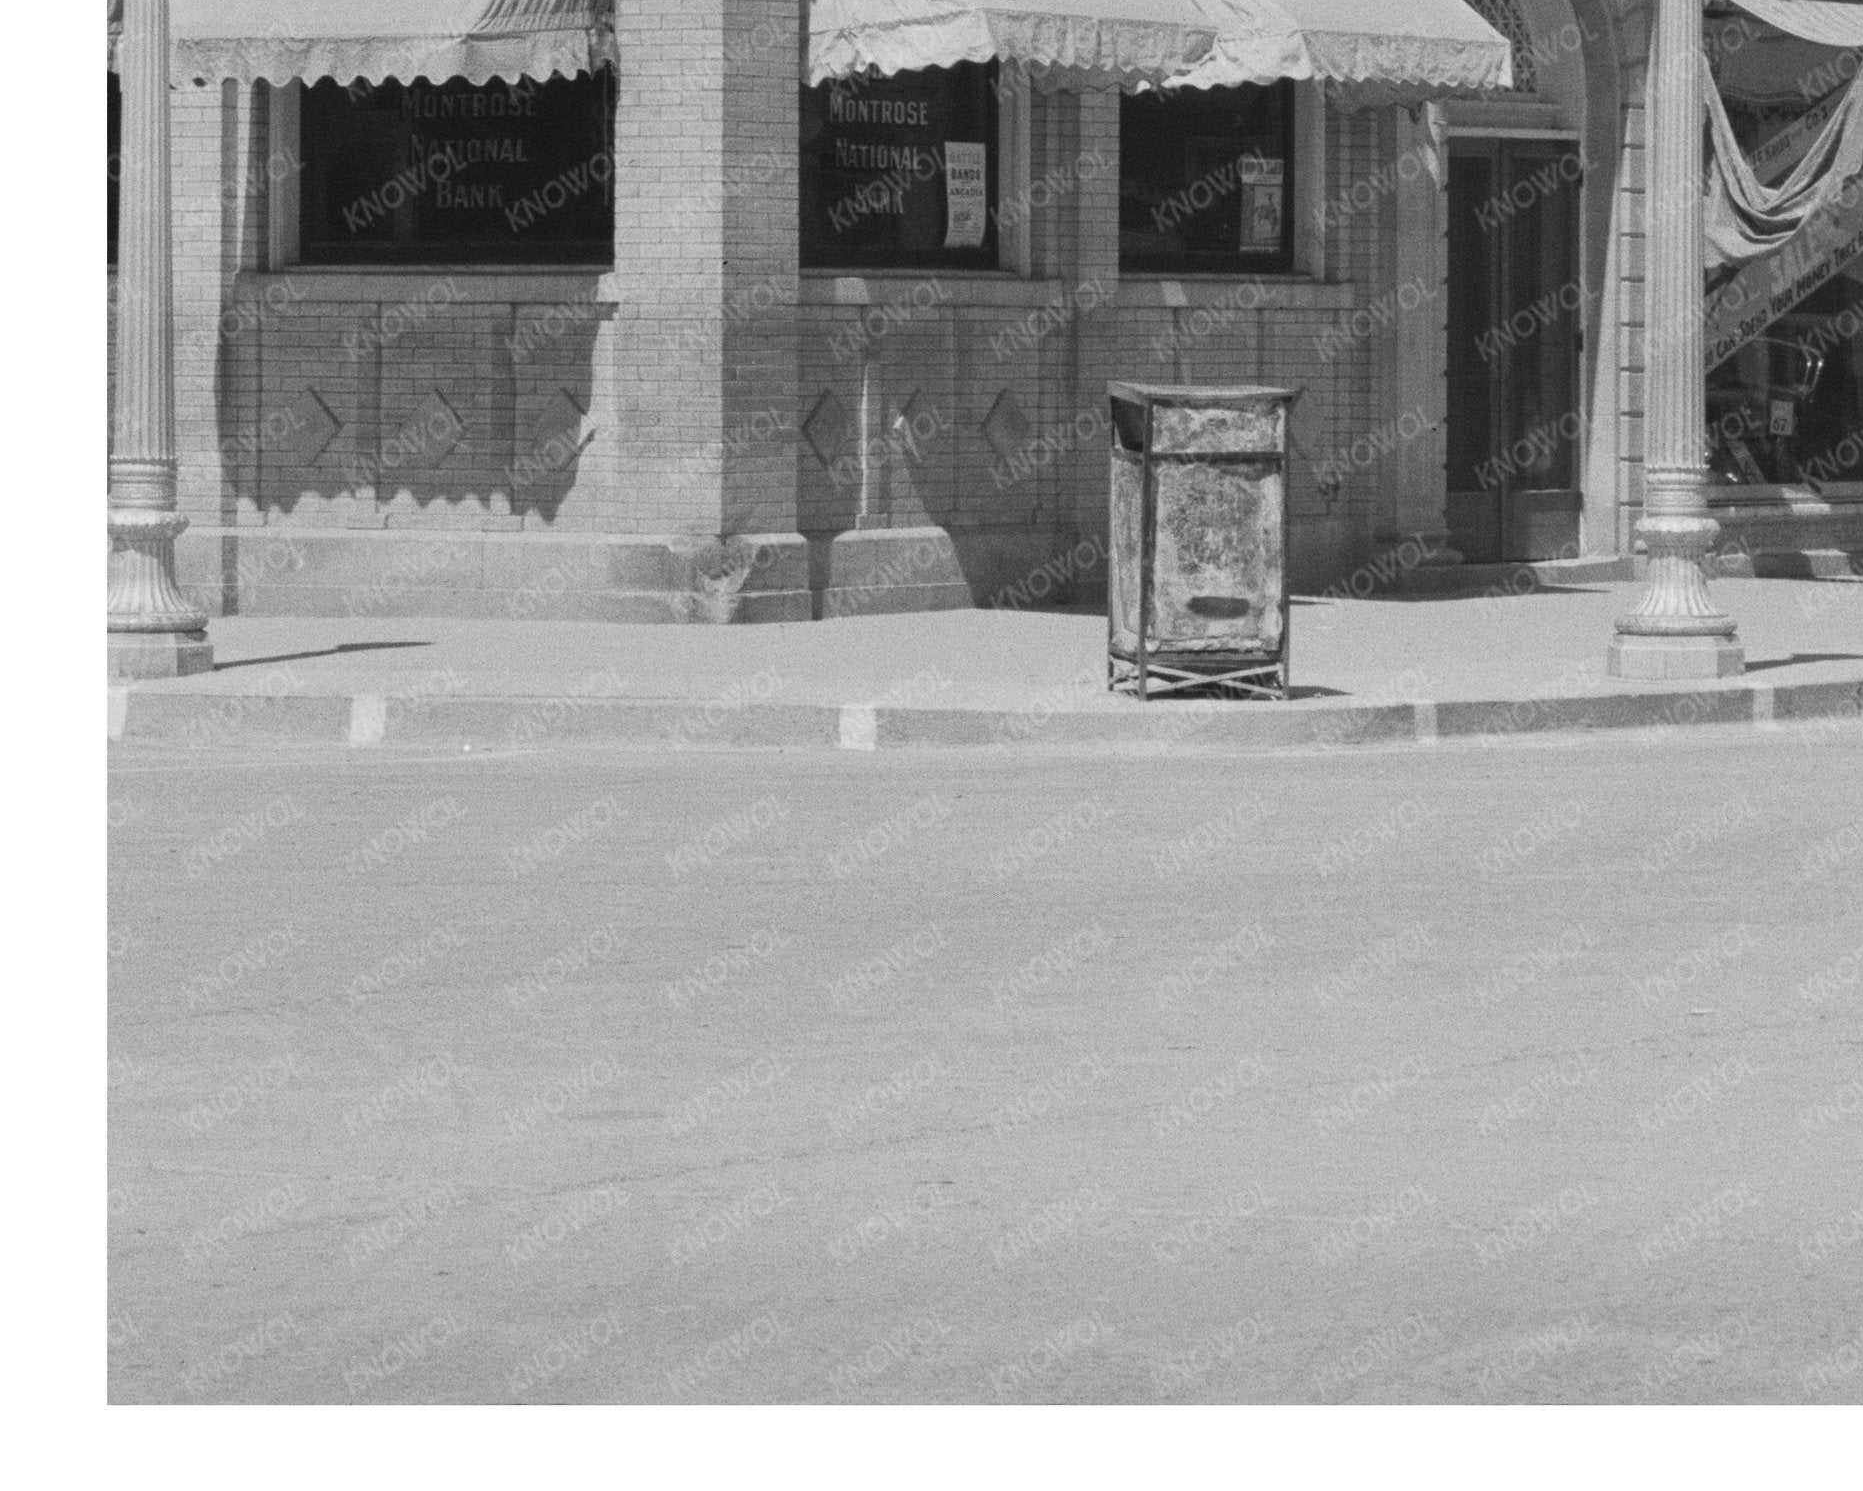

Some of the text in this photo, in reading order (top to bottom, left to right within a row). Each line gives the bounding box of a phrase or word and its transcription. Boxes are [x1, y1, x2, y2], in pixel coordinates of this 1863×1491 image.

[401, 87, 537, 119] MONTROSE
[829, 92, 929, 126] MONTROSE
[410, 133, 529, 163] NATIONAL
[835, 138, 924, 170] NATIONAL
[436, 183, 505, 209] BANK
[855, 182, 905, 215] BANK
